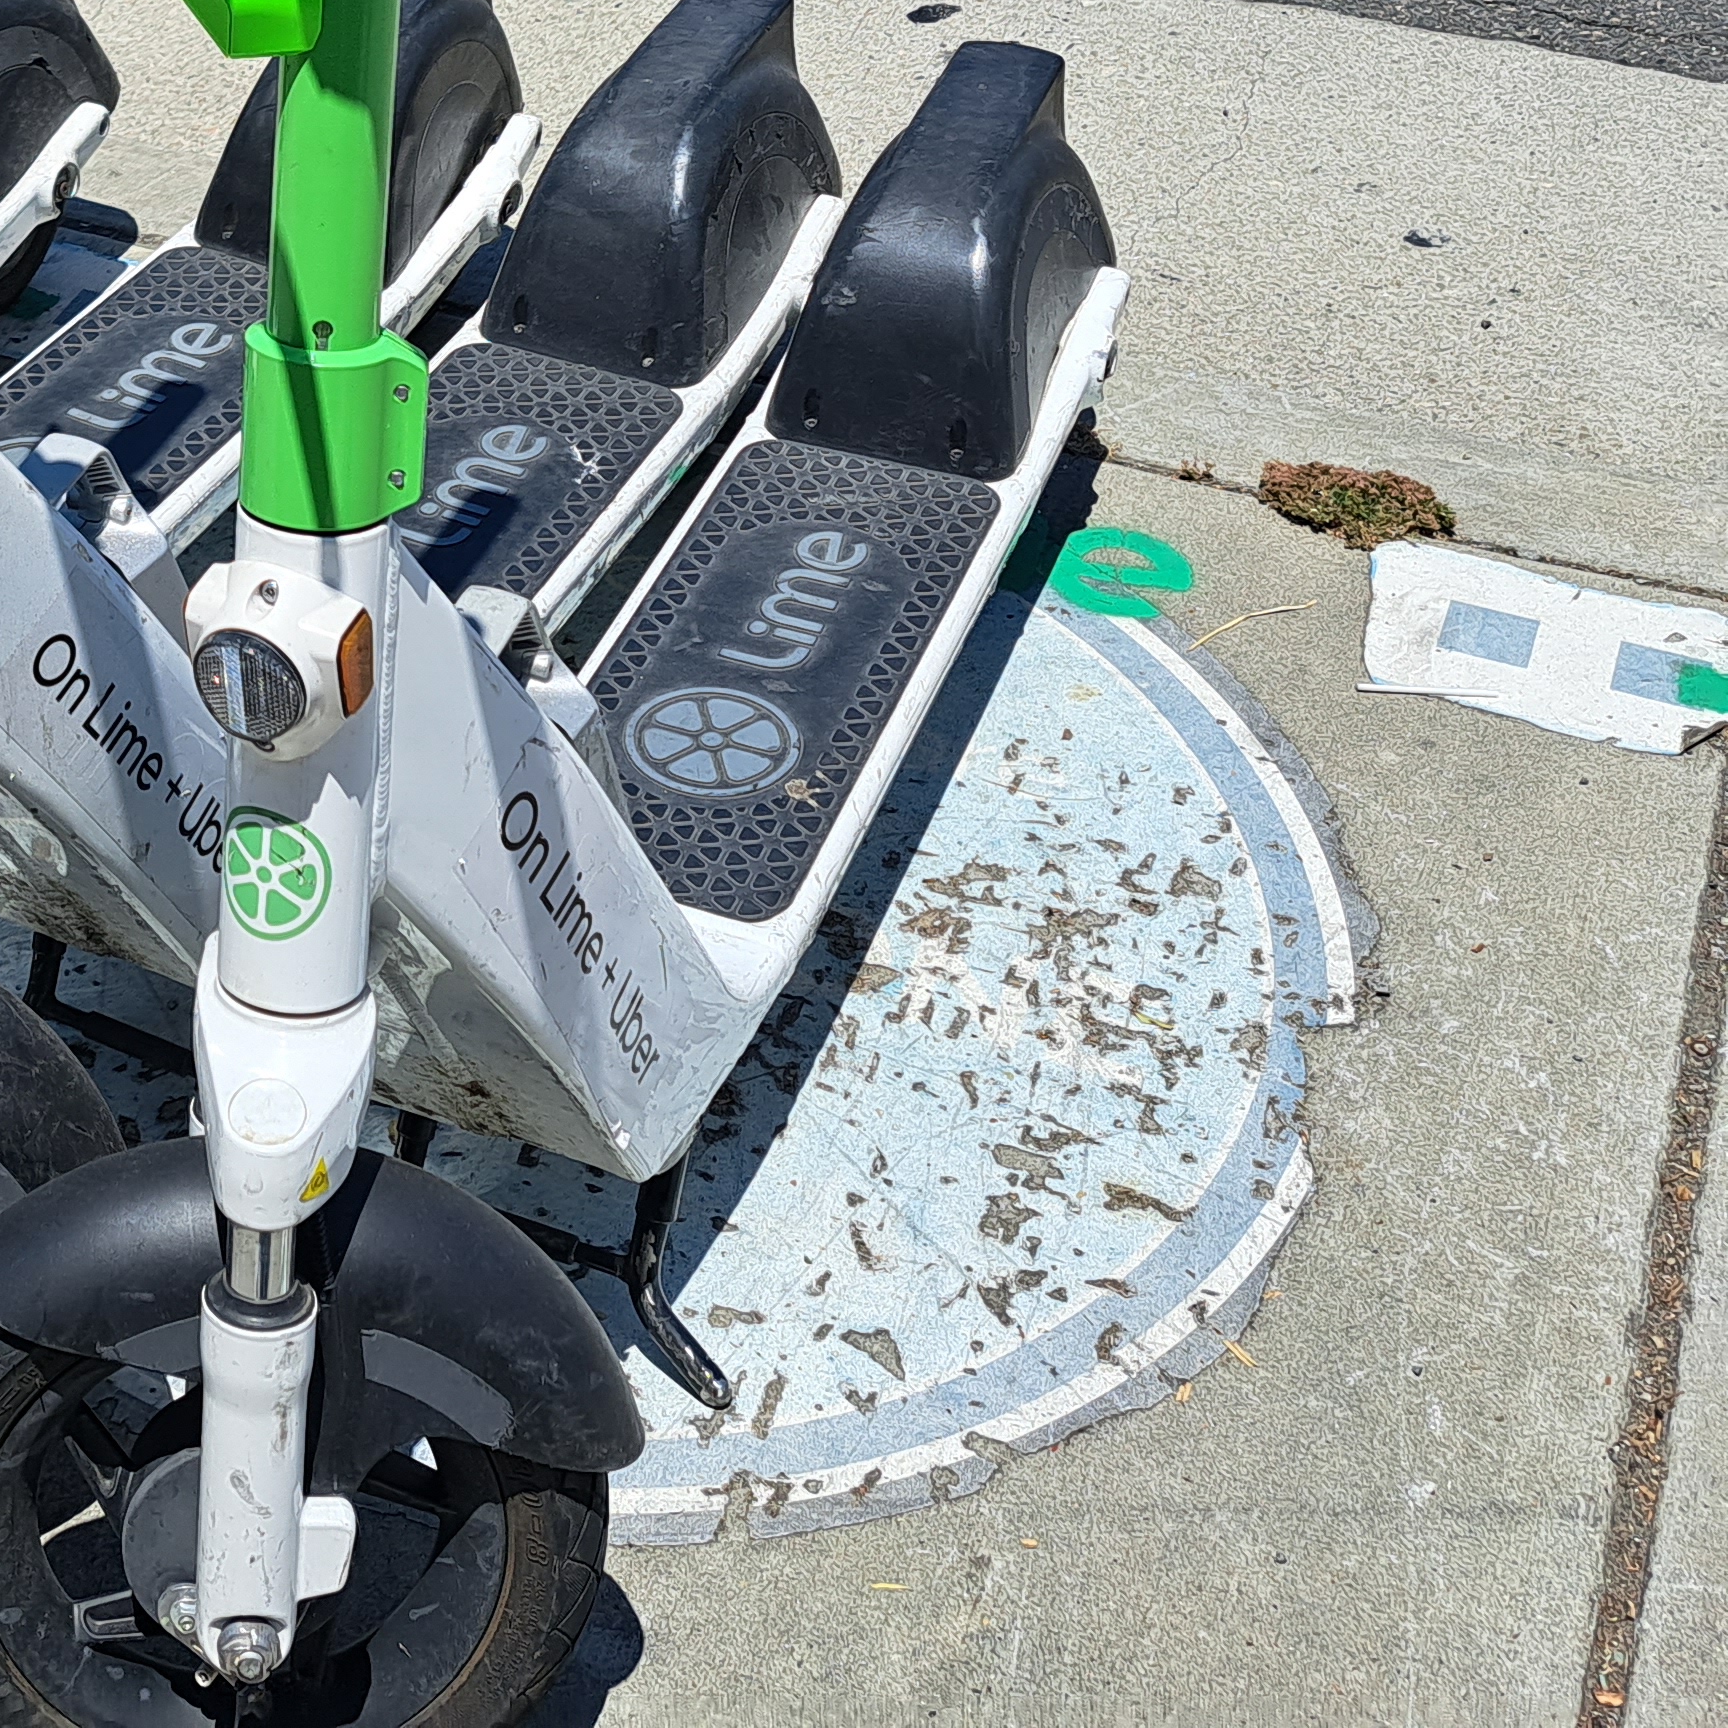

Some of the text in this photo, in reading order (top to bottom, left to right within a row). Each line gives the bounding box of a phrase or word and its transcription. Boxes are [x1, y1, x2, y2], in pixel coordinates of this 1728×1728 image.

[67, 321, 235, 432] Lime
[400, 424, 549, 547] Lime
[717, 530, 869, 670] Lime
[32, 633, 91, 716] On
[81, 682, 164, 792] Lime
[162, 772, 186, 804] +
[500, 790, 662, 1086] On Lime + Uber
